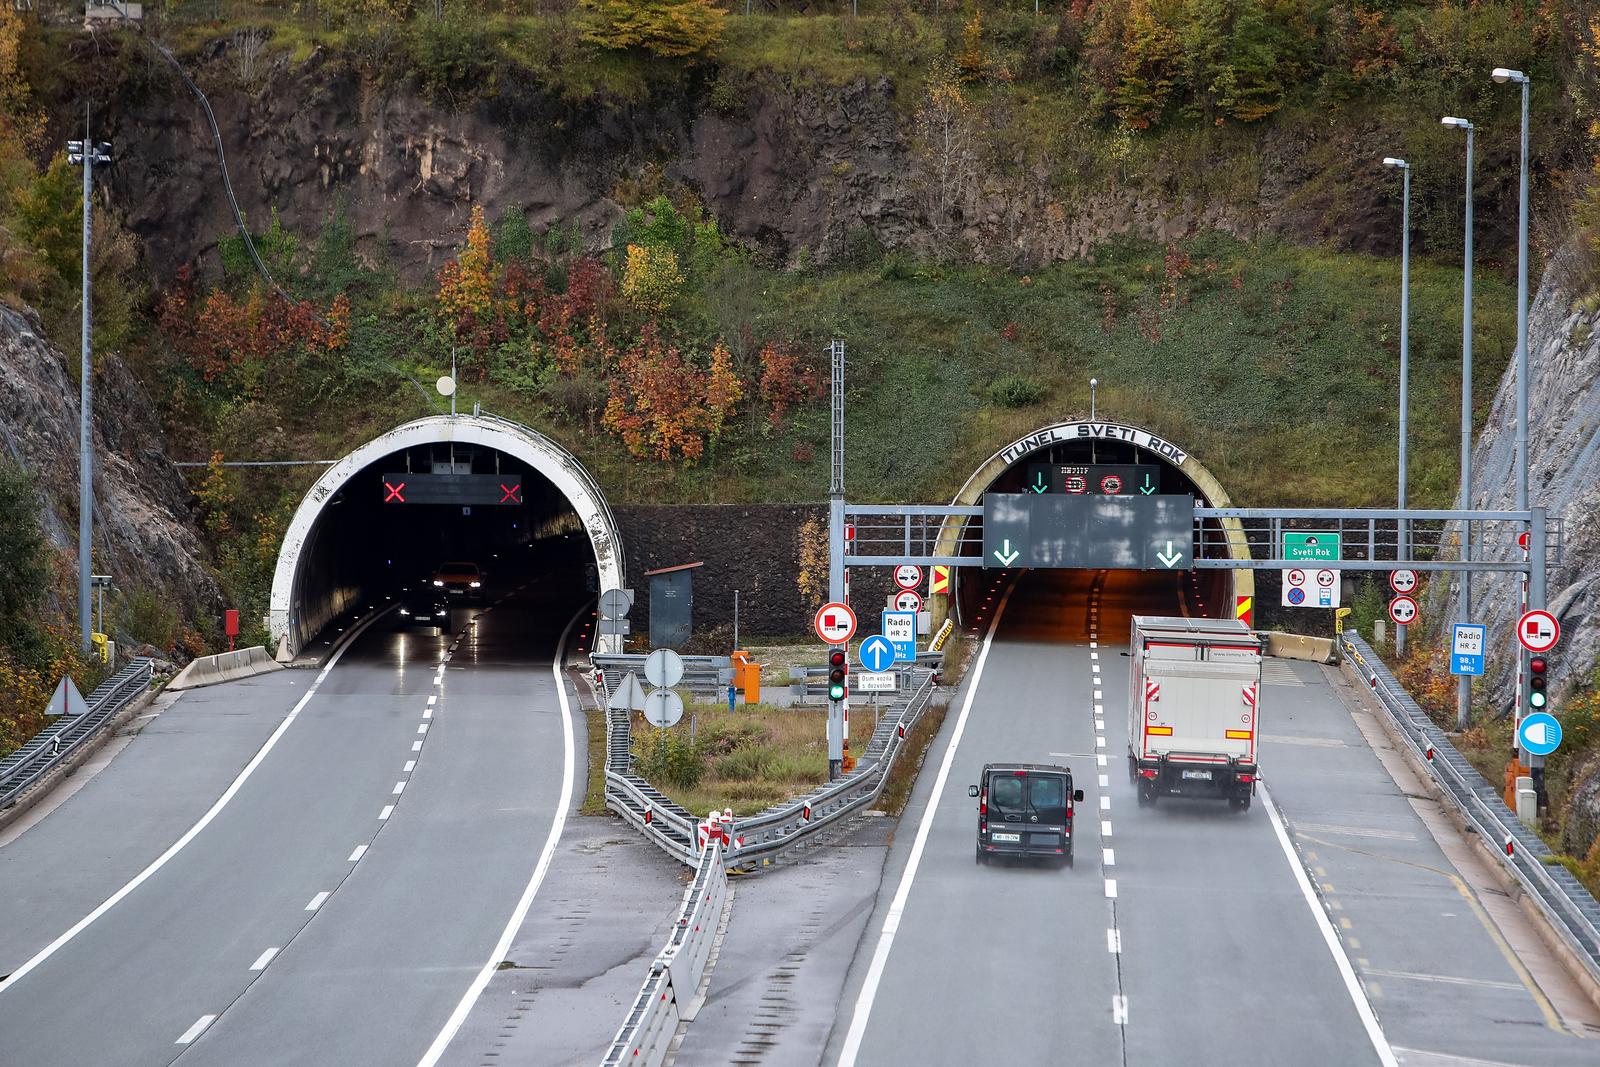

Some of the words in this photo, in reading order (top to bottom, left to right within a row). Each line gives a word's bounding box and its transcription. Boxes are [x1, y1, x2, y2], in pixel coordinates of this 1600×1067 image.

[1002, 430, 1063, 463] TUNEL
[1077, 424, 1136, 442] SVETI
[1147, 437, 1187, 466] ROK
[1292, 548, 1313, 556] Sveti
[1315, 548, 1331, 556] Rok
[887, 618, 911, 626] Radio
[1457, 631, 1481, 640] Radio
